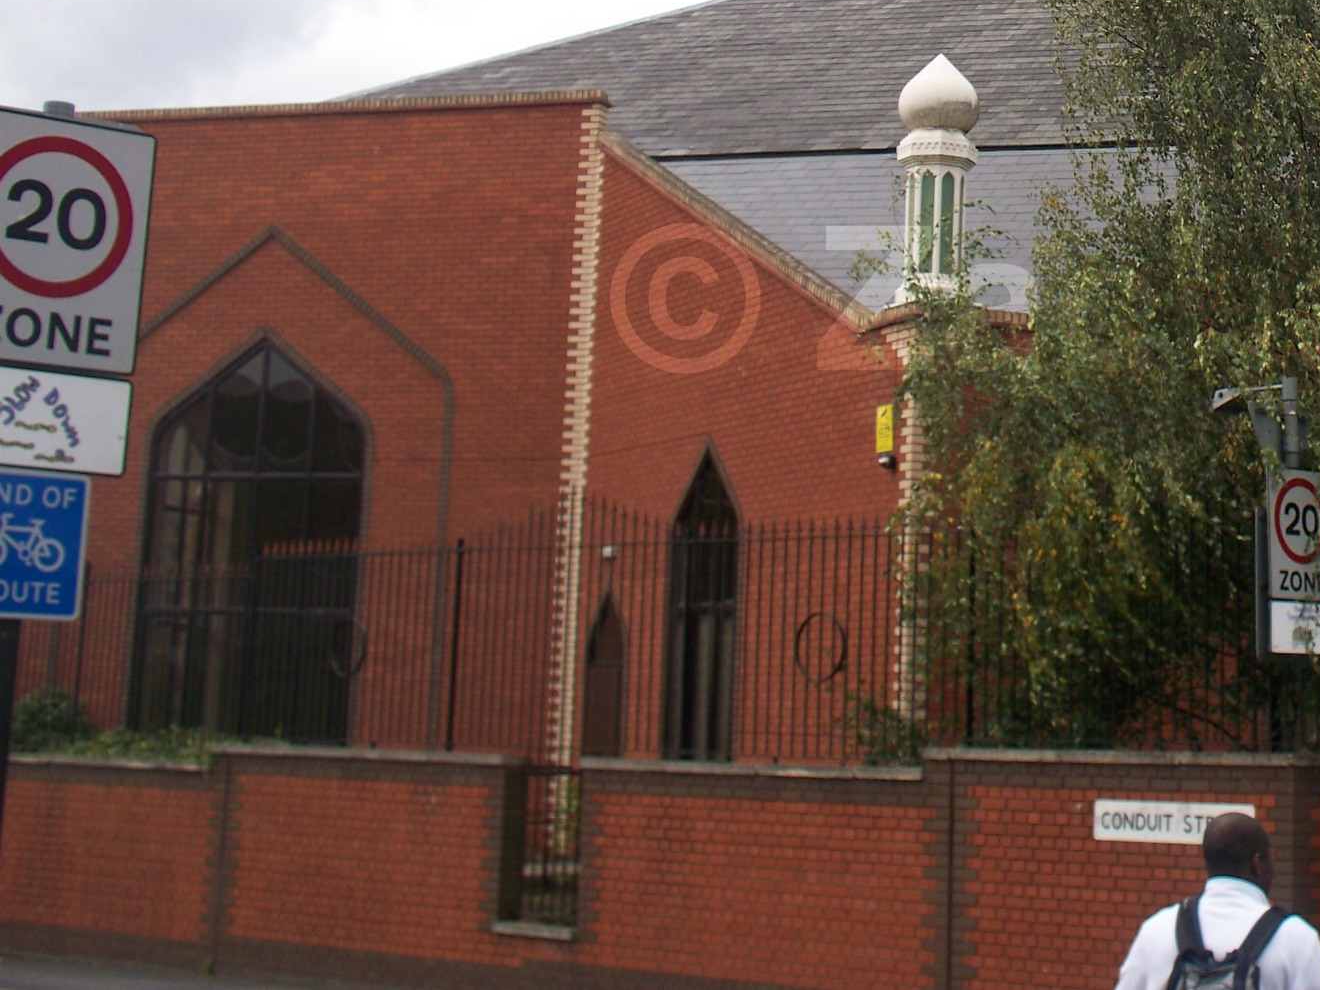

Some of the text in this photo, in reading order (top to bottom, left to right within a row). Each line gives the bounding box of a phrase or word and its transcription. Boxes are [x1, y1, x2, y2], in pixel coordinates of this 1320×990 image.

[5, 178, 107, 251] 20
[0, 304, 113, 357] ONE
[0, 482, 77, 509] ND OF
[1284, 502, 1319, 537] 20
[0, 578, 61, 605] OUTE
[1101, 812, 1174, 833] CONDUIT
